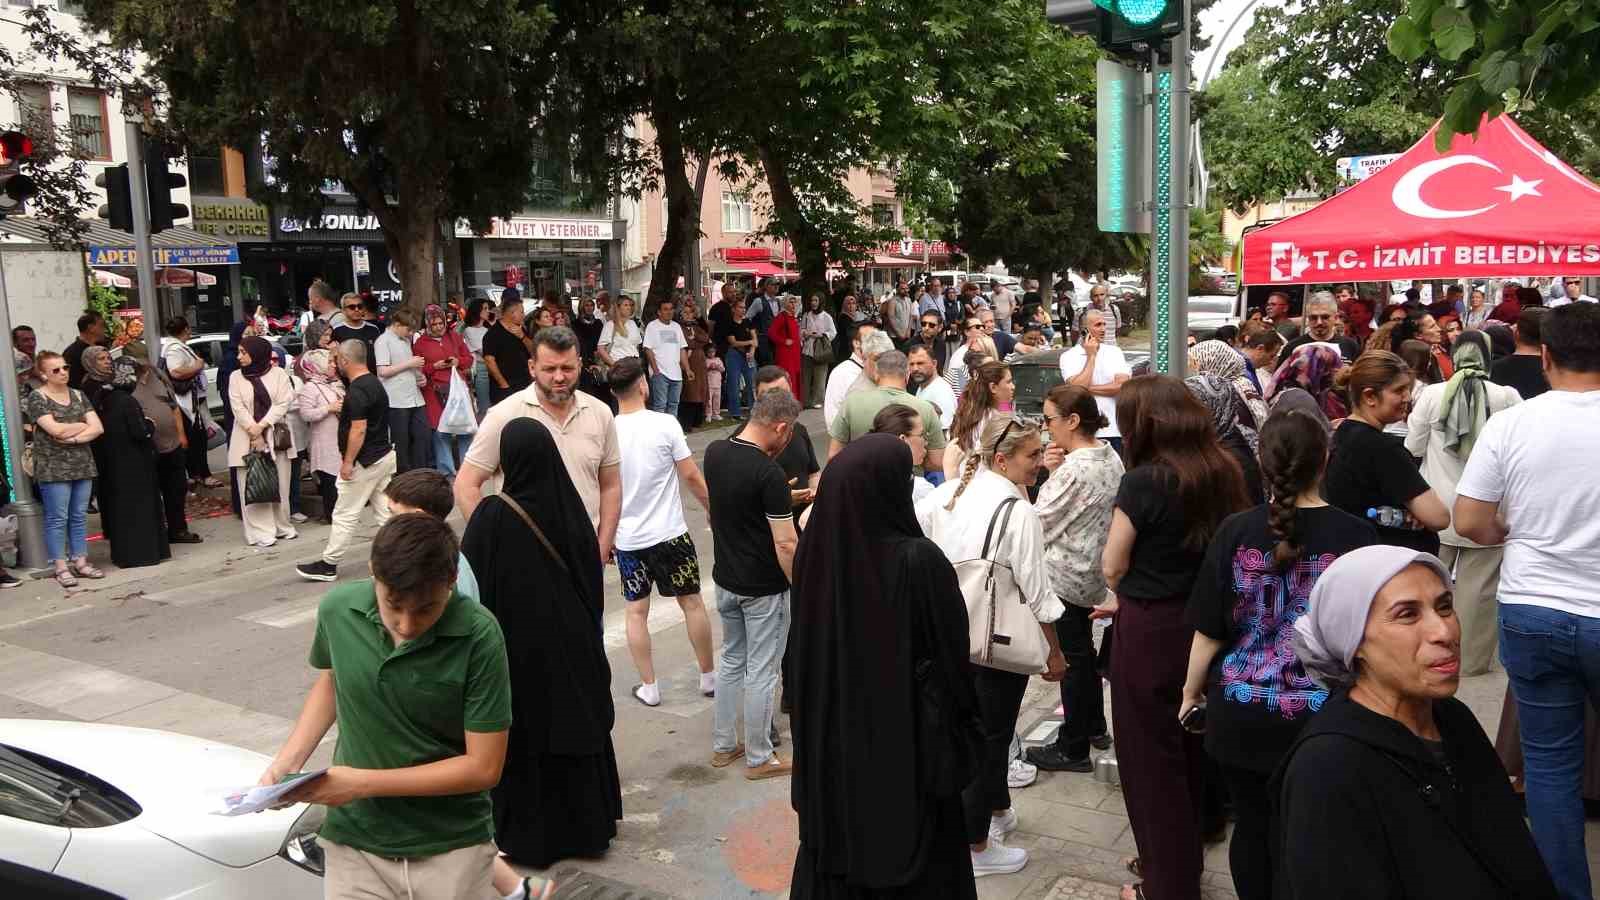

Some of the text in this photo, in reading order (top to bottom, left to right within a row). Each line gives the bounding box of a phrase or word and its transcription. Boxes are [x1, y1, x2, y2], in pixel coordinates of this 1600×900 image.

[225, 222, 269, 236] OFFICE
[543, 222, 600, 238] VETERİNER
[1312, 240, 1600, 270] T.C. İZMİT BELEDİYES
